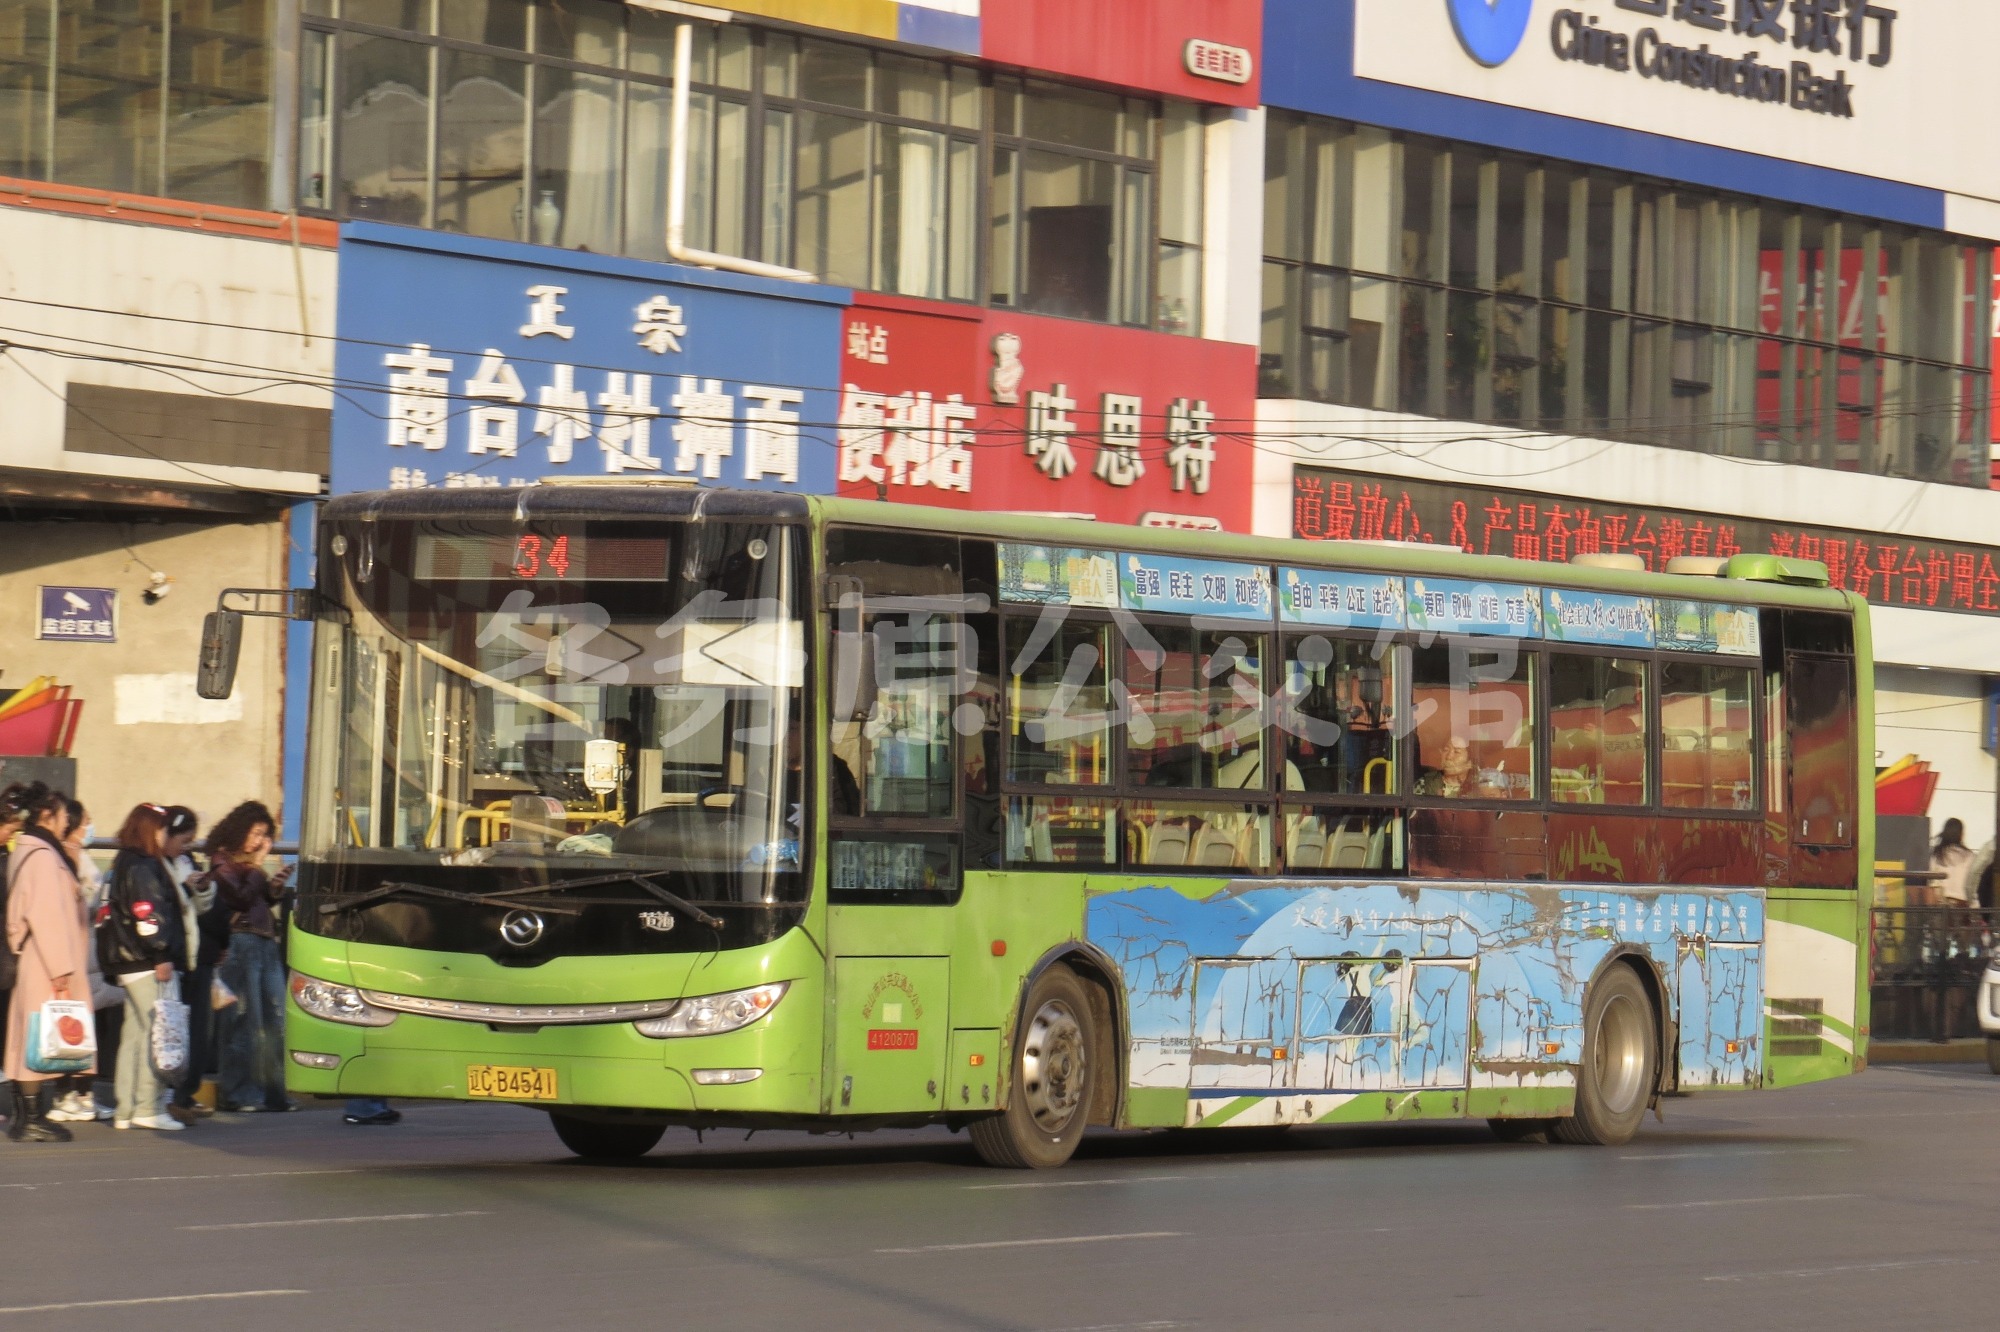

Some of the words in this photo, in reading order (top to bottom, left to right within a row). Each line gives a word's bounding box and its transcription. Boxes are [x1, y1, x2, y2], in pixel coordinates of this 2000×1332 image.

[1550, 8, 1630, 72] China
[1635, 27, 1787, 104] Construction
[1789, 60, 1855, 119] Bank
[518, 284, 688, 355] 正宗
[847, 321, 889, 365] 站点
[839, 382, 977, 493] 便利店
[1025, 382, 1217, 494] 味思特
[517, 534, 569, 579] 34
[1135, 567, 1161, 597] 富强
[1169, 572, 1194, 600] 民主
[1202, 574, 1227, 604] 文明
[1235, 578, 1260, 607] 和谐
[1291, 584, 1313, 610] 自由
[1319, 587, 1340, 612] 平等
[1346, 591, 1366, 614] 公正
[1372, 594, 1393, 618] 法治
[1424, 591, 1445, 618] 爱国
[1451, 593, 1473, 620] 敬业
[1478, 596, 1499, 622] 诚信
[1505, 598, 1526, 625] 友善
[42, 617, 113, 637] 监控区域
[639, 911, 674, 931] 黄海
[871, 1032, 915, 1047] 4120870
